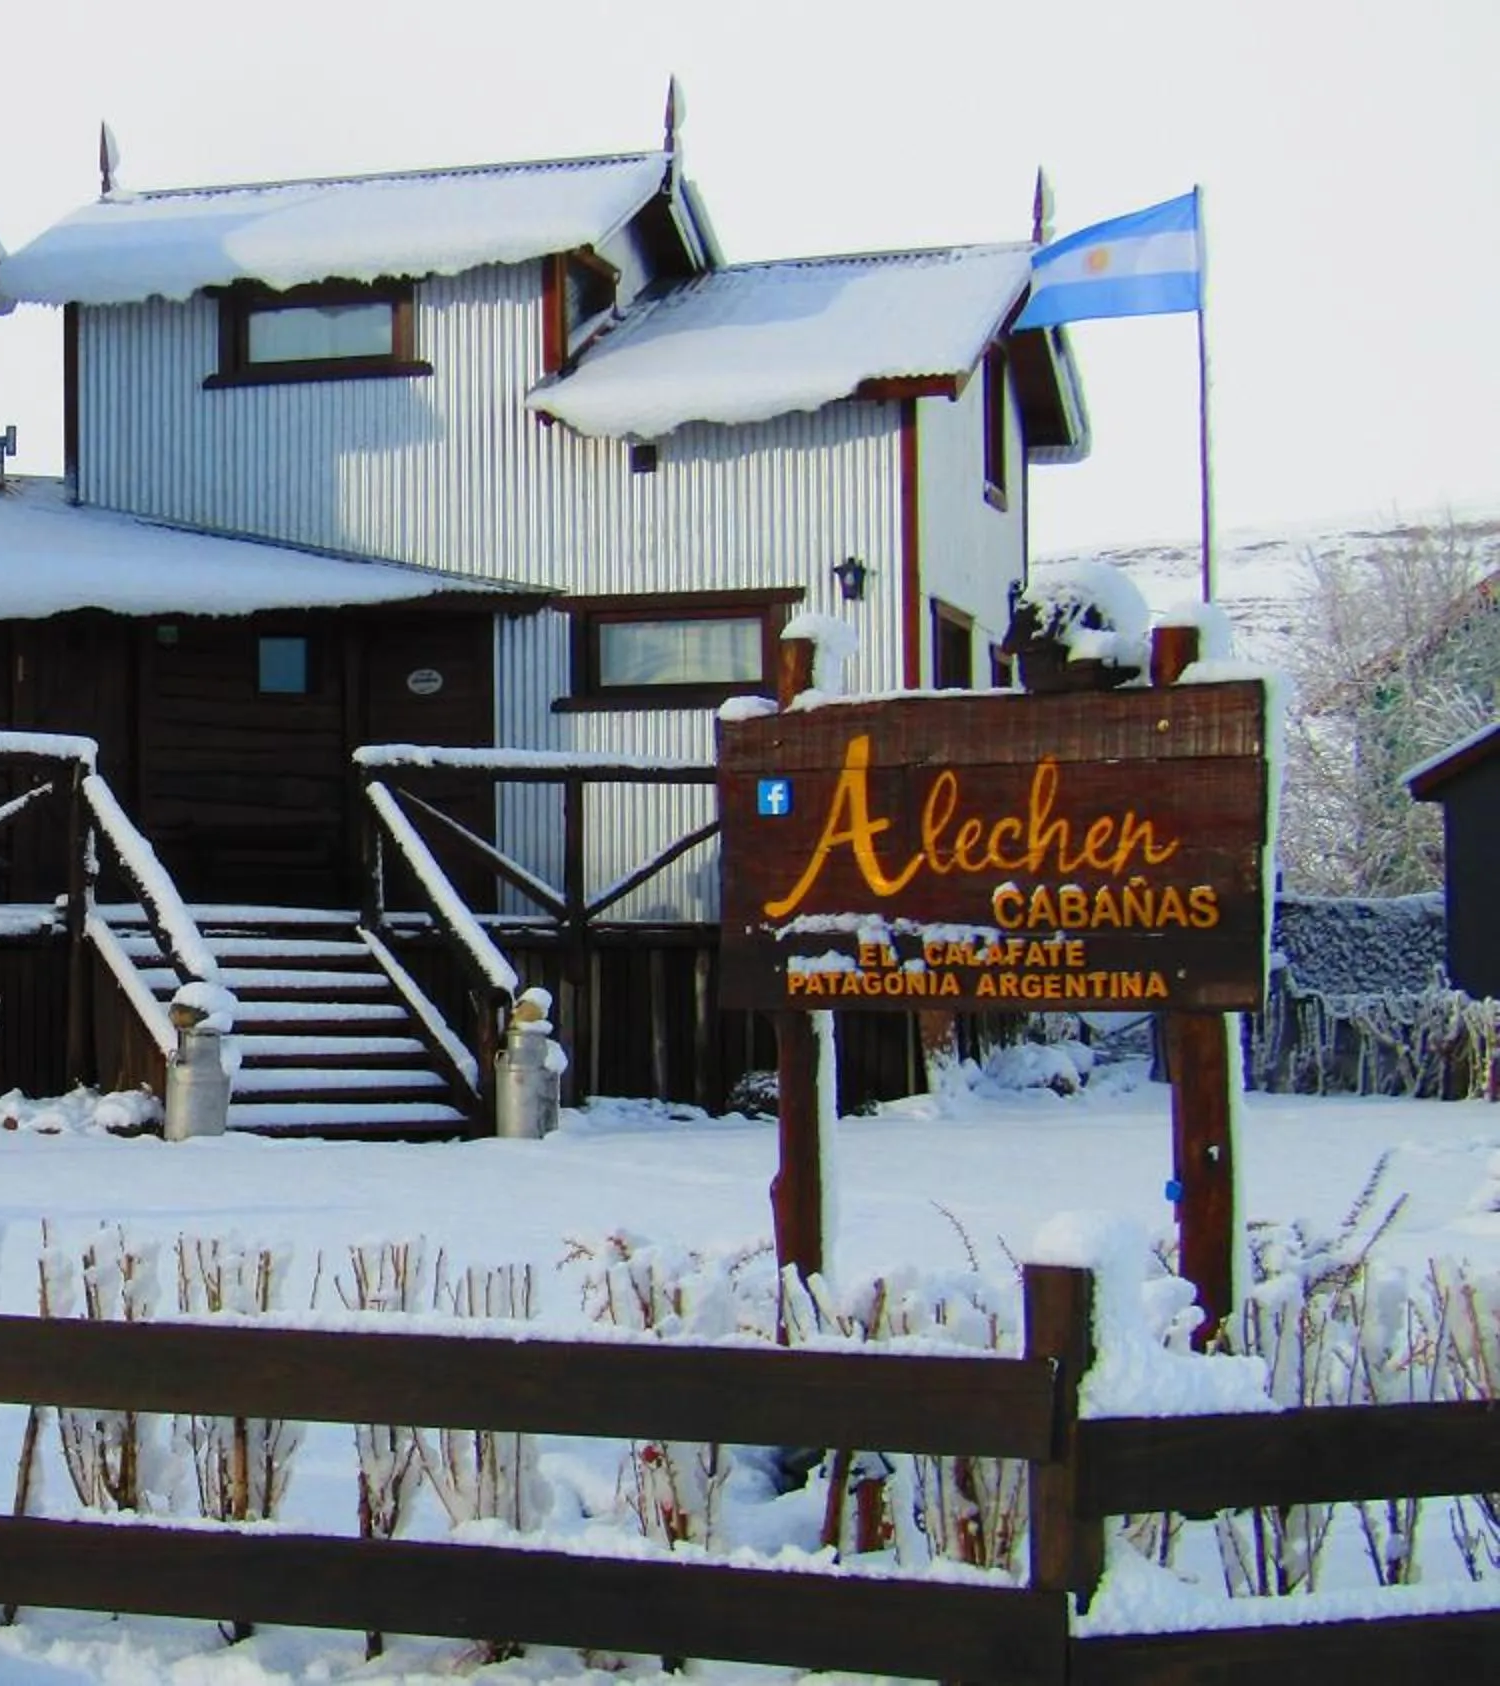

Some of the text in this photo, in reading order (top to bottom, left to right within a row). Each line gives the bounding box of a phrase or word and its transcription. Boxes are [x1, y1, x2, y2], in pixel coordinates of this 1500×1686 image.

[763, 734, 1180, 918] Alechen
[994, 876, 1220, 928] CABAÑAS
[860, 939, 1086, 968] EL CALAFATE
[787, 970, 1169, 998] PATAGONIA ARGENTINA
